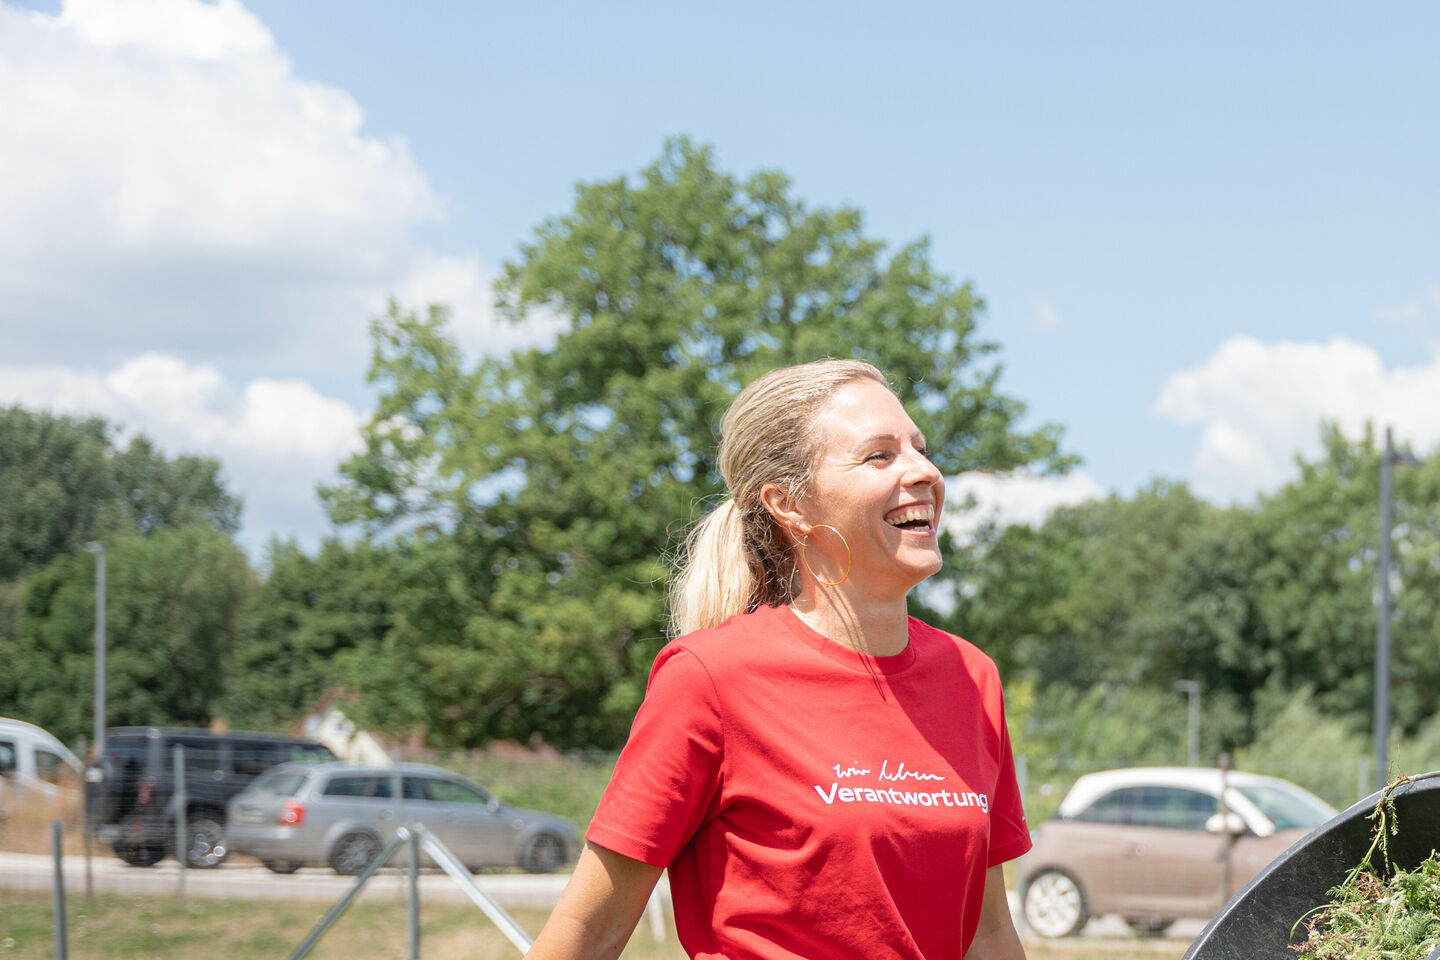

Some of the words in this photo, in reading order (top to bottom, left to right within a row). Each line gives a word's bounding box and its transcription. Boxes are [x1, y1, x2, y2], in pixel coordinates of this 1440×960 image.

[833, 761, 871, 778] wir
[878, 759, 945, 781] leben
[814, 782, 988, 813] Verantwortung
